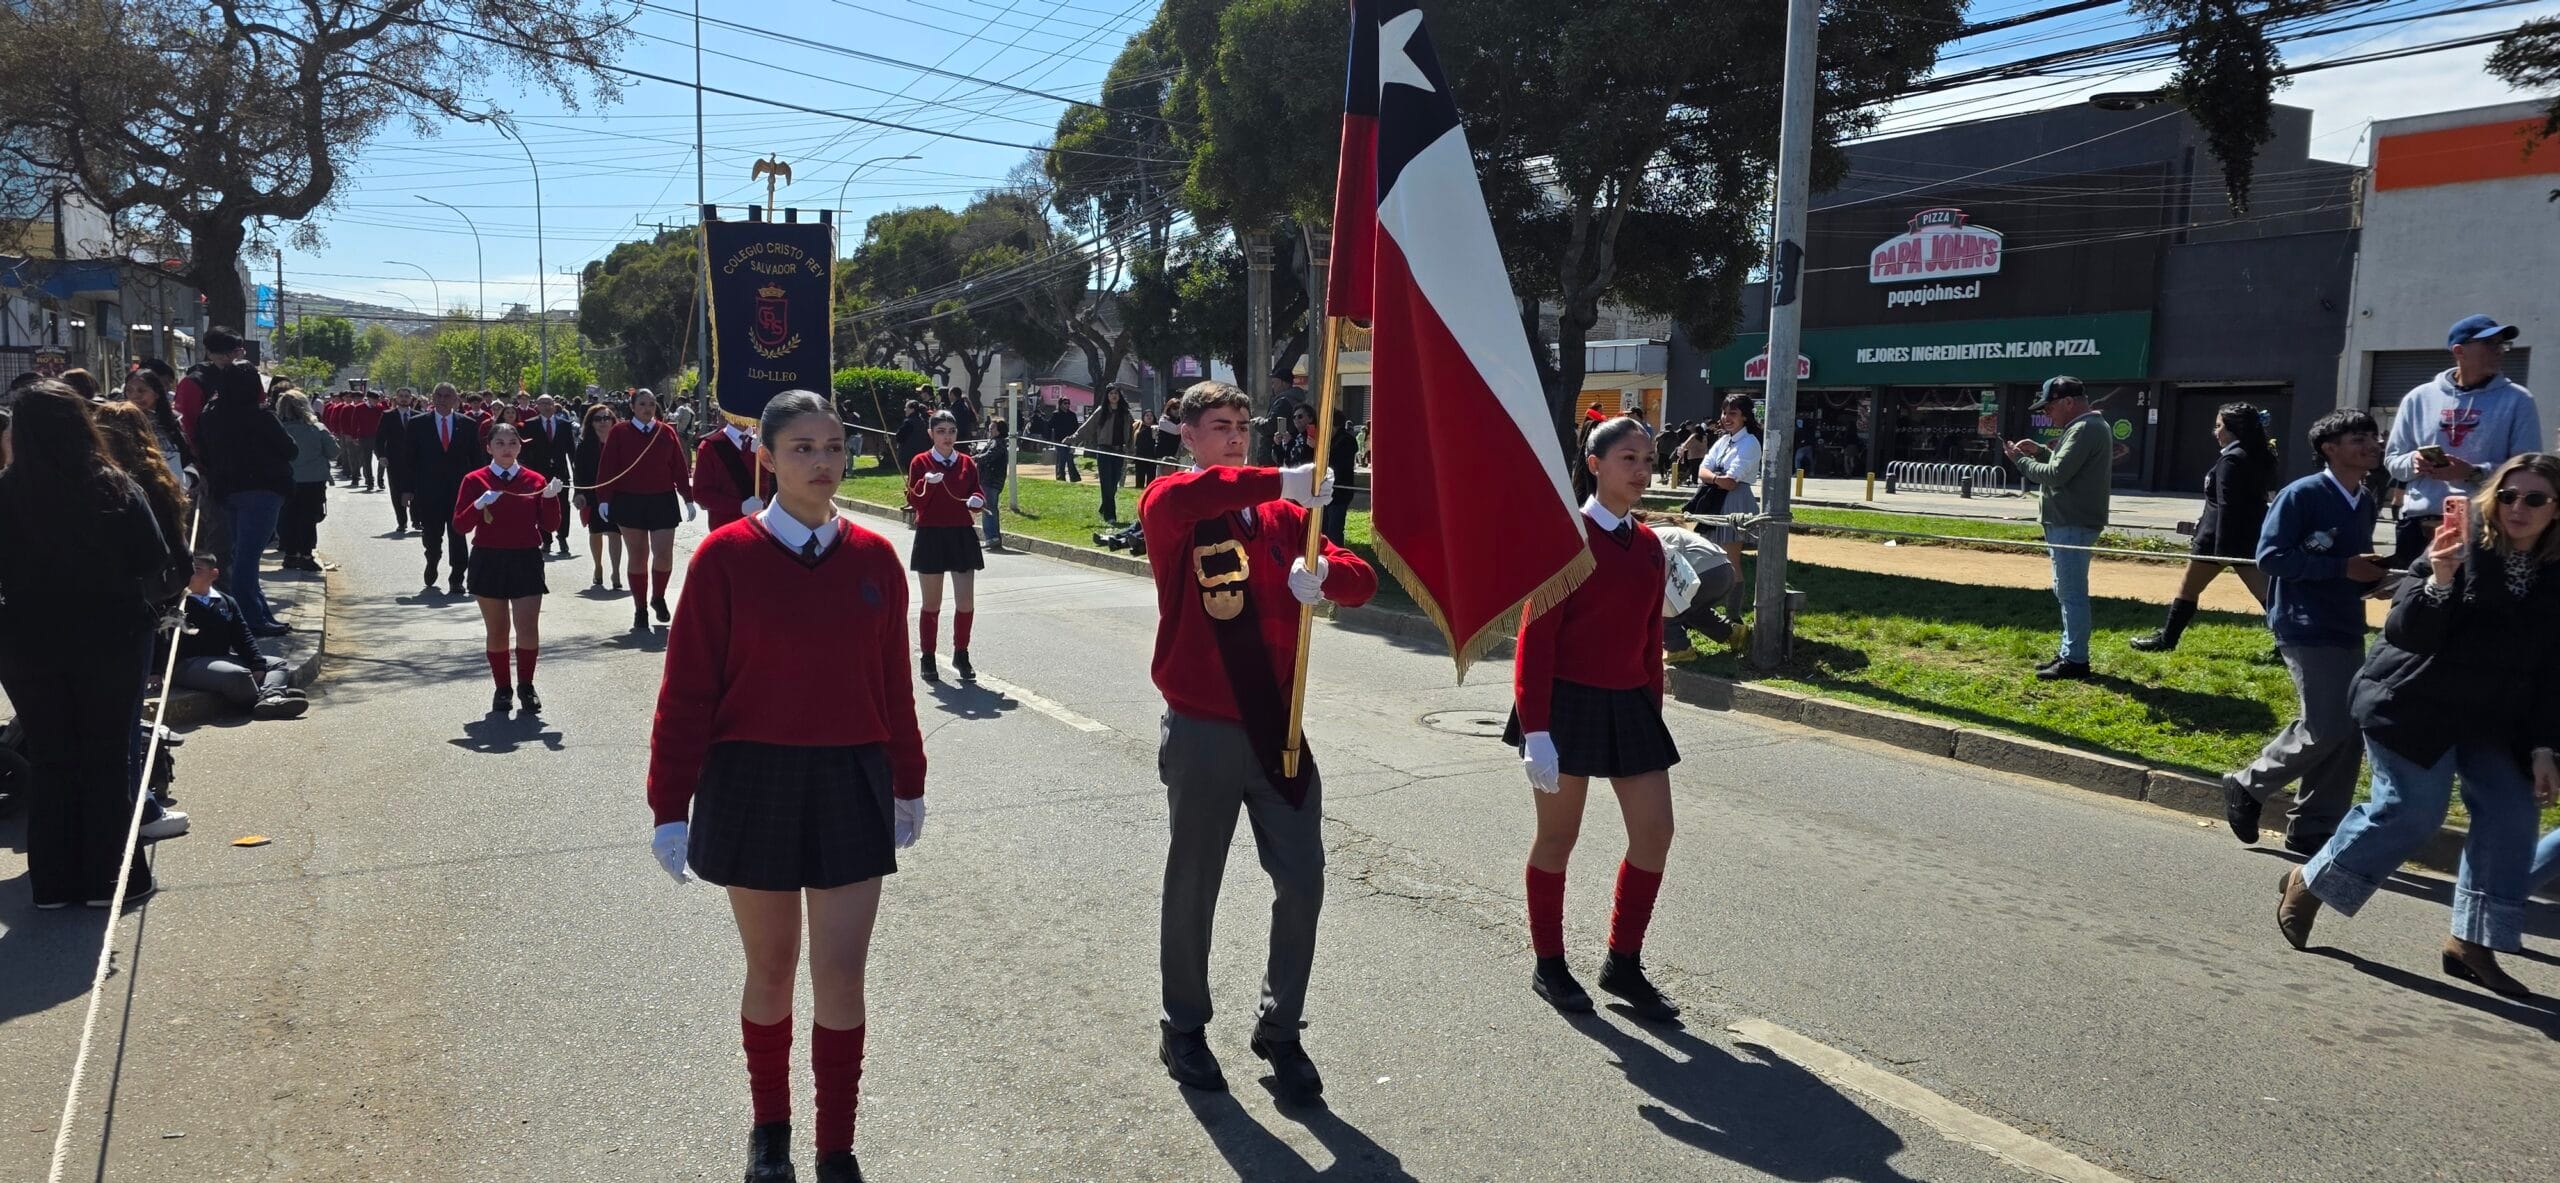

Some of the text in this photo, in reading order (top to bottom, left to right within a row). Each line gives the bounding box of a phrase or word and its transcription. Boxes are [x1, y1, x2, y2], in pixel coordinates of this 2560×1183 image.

[1923, 212, 1950, 225] PIZZA
[723, 242, 825, 278] COLEGIO CRISTO REY
[1873, 233, 1998, 277] PAPA JOHN'S
[750, 260, 797, 275] SALVADOR
[1887, 280, 1981, 308] papajohns.cl
[1856, 346, 1910, 363] MEJORES
[2055, 339, 2101, 357] PIZZA.
[1746, 358, 1768, 378] PAP
